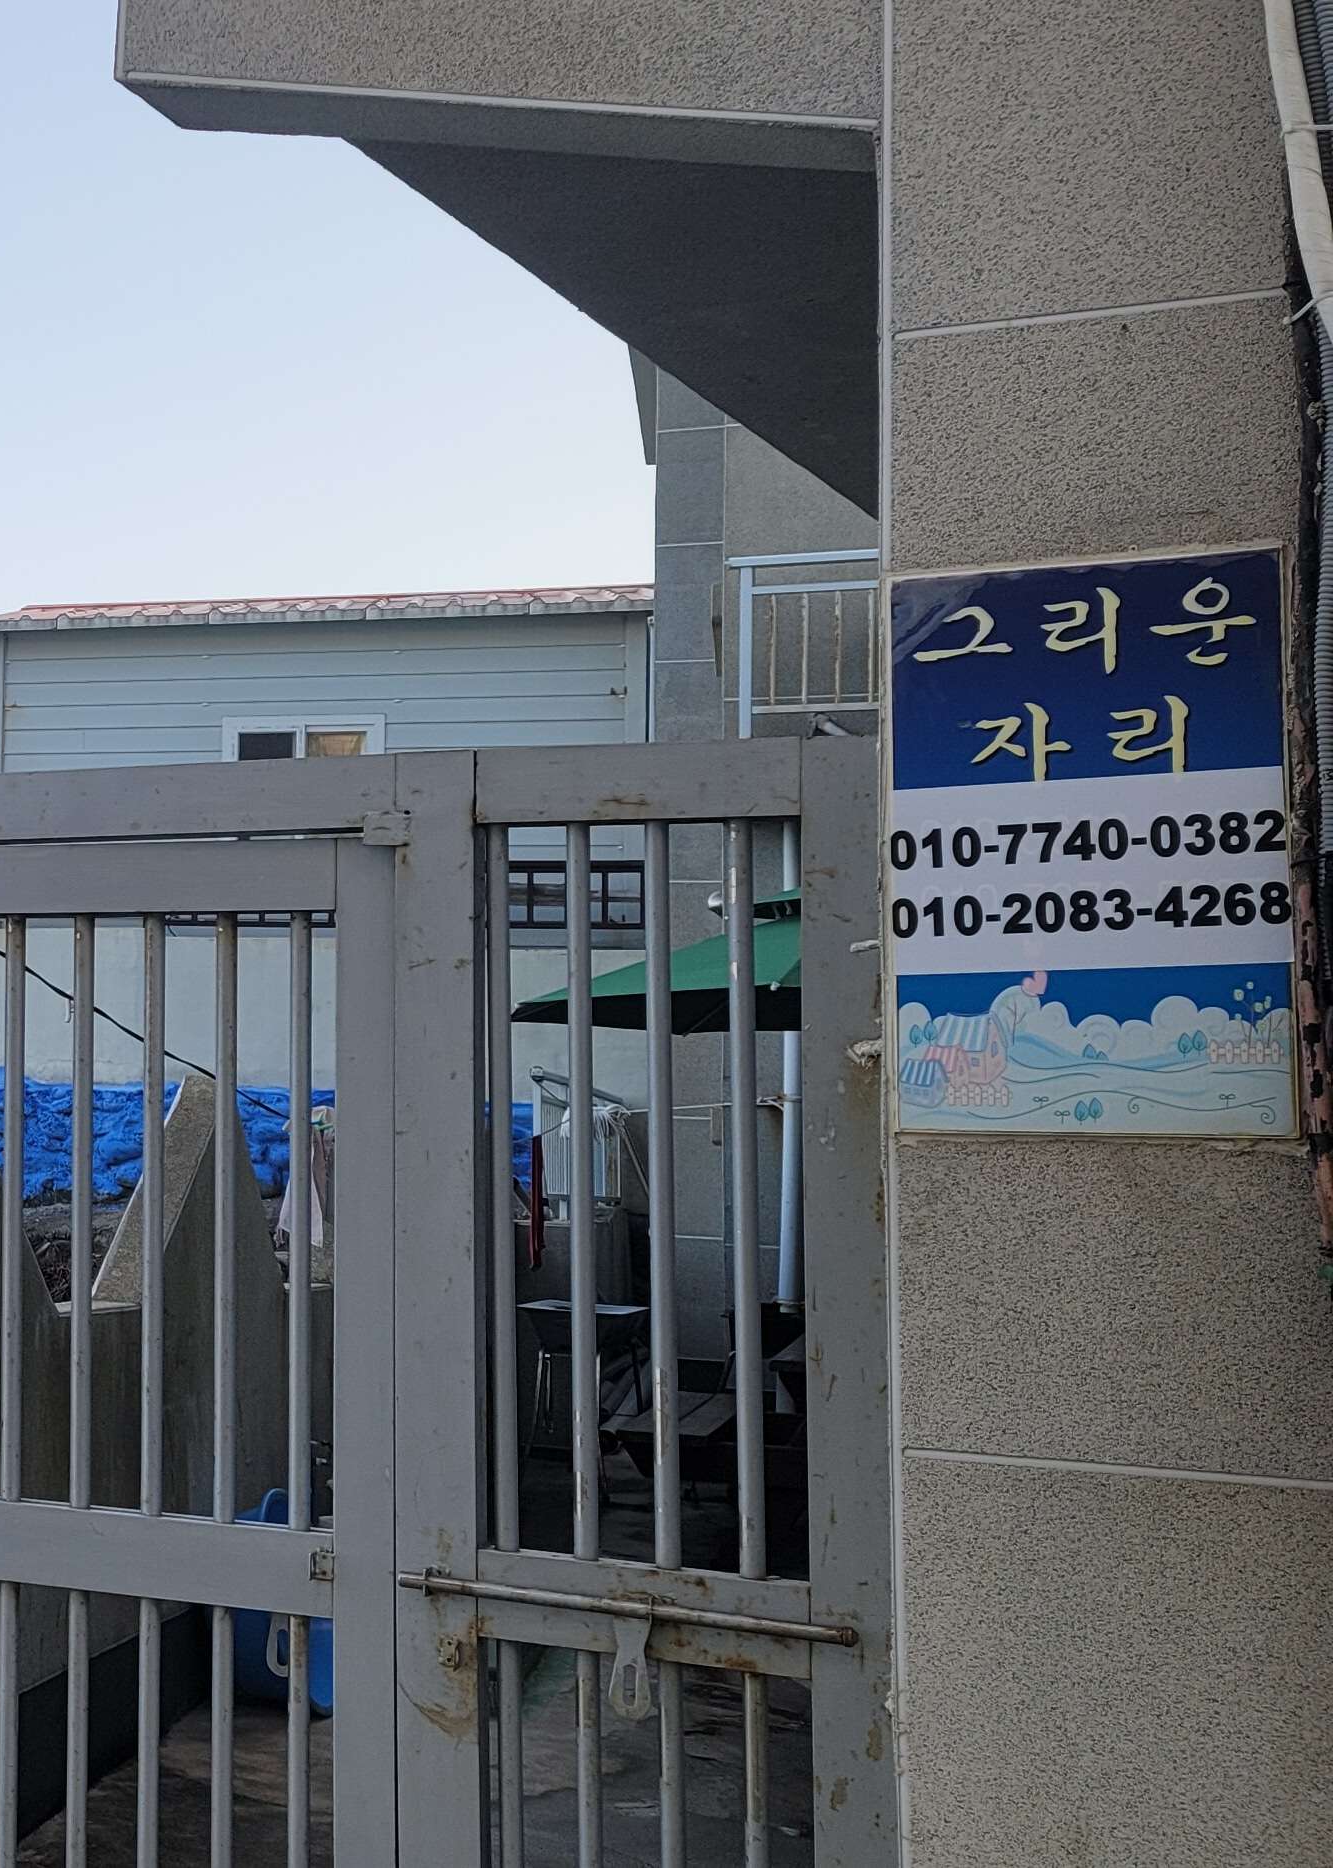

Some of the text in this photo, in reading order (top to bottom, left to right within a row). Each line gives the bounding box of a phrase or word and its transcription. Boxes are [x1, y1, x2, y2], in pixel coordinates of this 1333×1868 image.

[912, 576, 1257, 675] 그리운
[970, 694, 1190, 782] 자리
[889, 808, 1287, 872] 010-7740-0382
[891, 880, 1293, 939] 010-2083-4268
